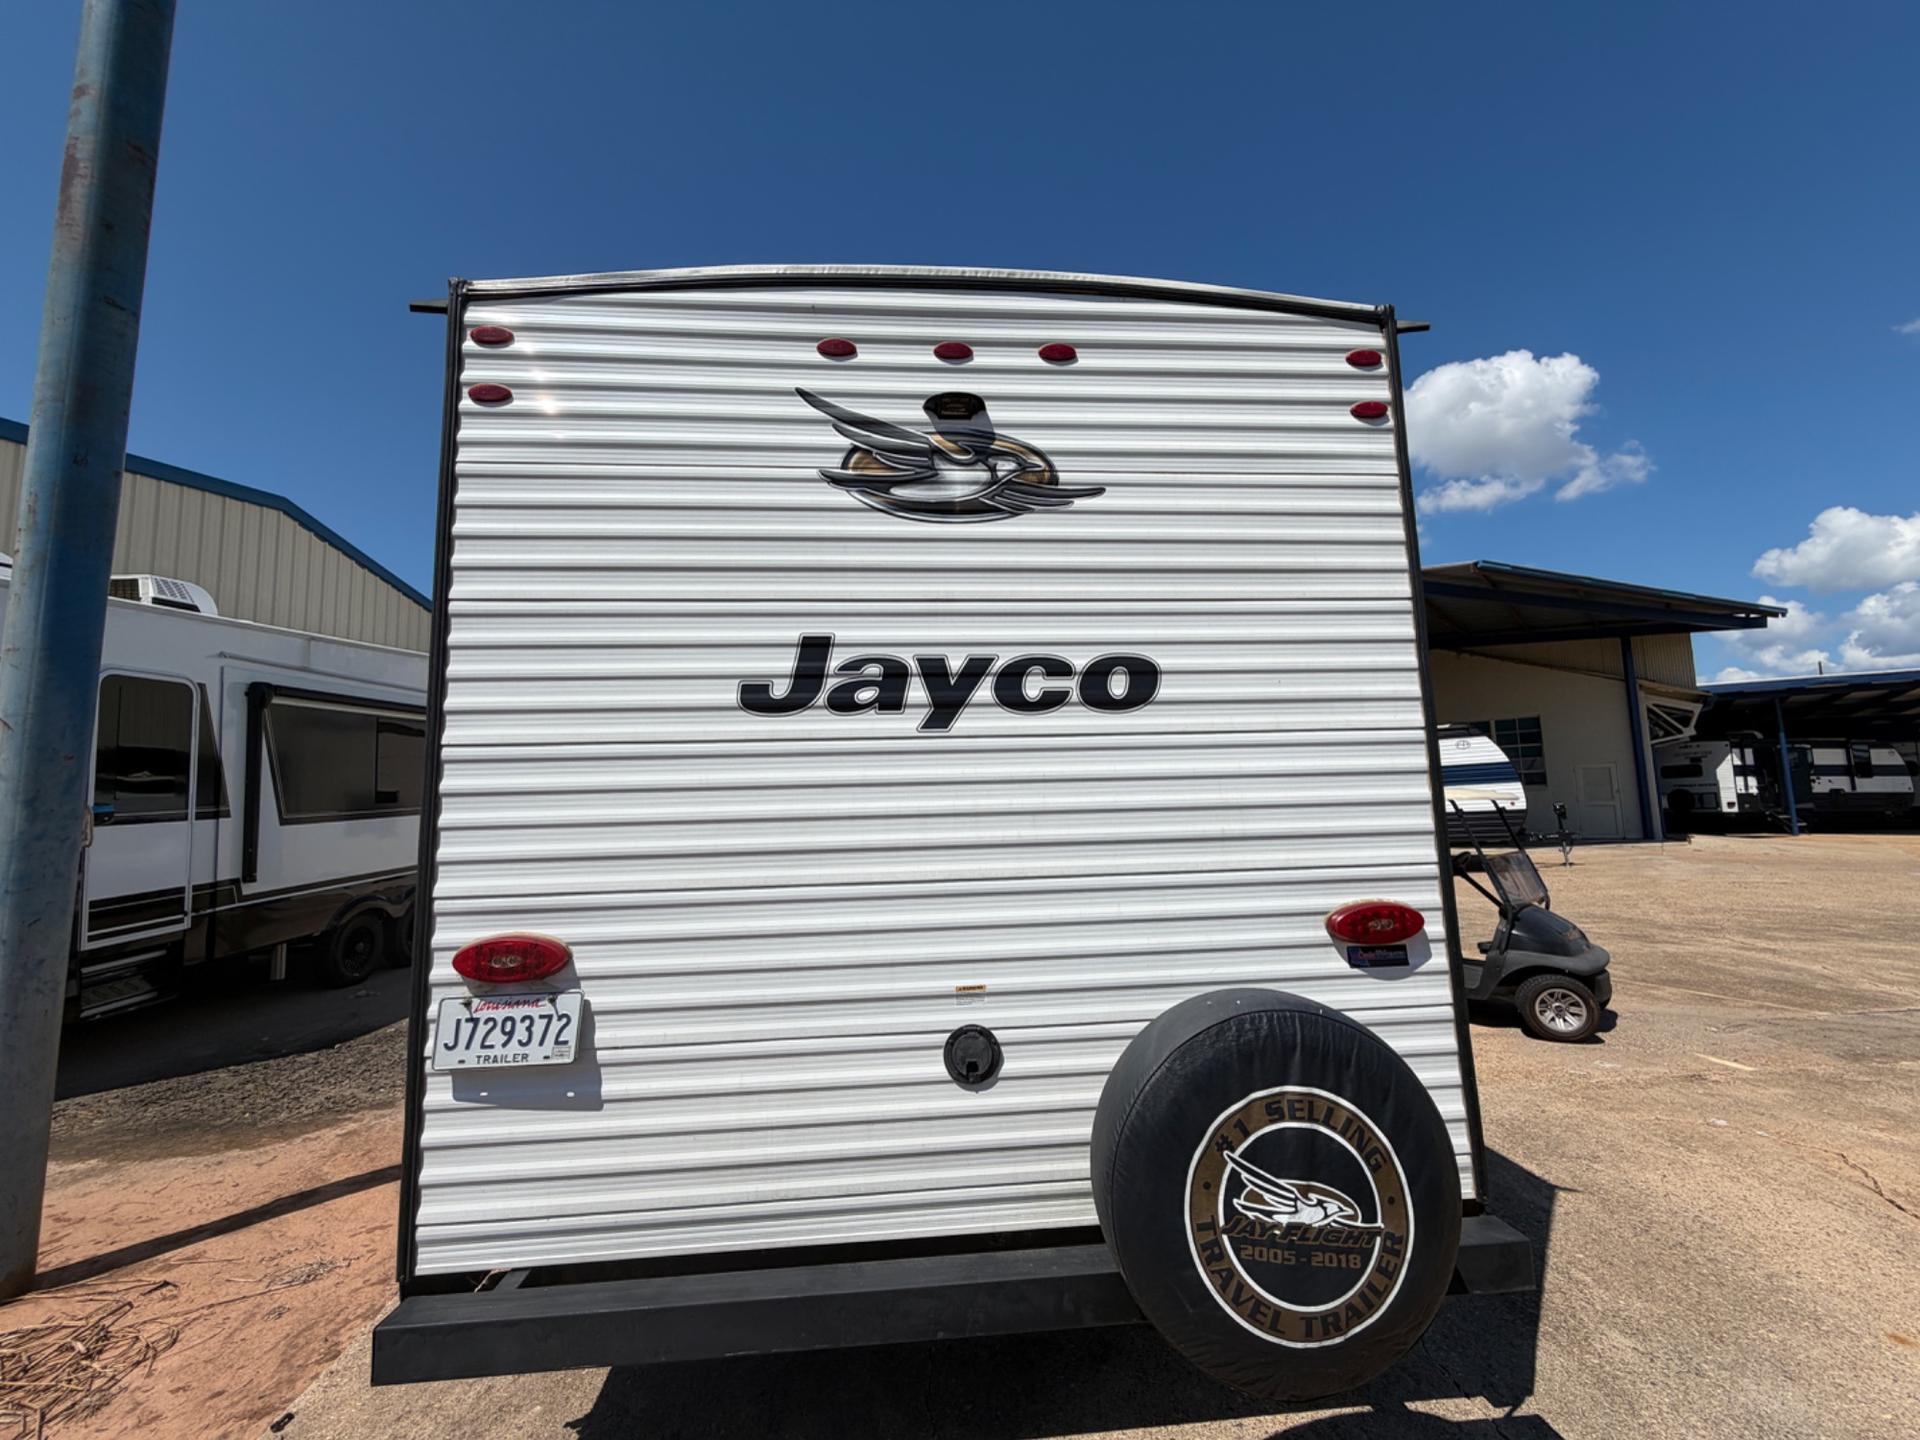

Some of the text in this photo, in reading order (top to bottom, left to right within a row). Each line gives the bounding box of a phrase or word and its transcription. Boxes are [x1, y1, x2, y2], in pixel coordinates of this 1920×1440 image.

[737, 632, 1162, 733] Jayco
[443, 1013, 571, 1051] J729372
[476, 1053, 529, 1065] TRAILER
[1265, 1099, 1387, 1174] SELLING
[1196, 1215, 1403, 1338] TRAVEL TRAILER
[1240, 1245, 1296, 1265] 2005
[1311, 1252, 1361, 1269] 2018
